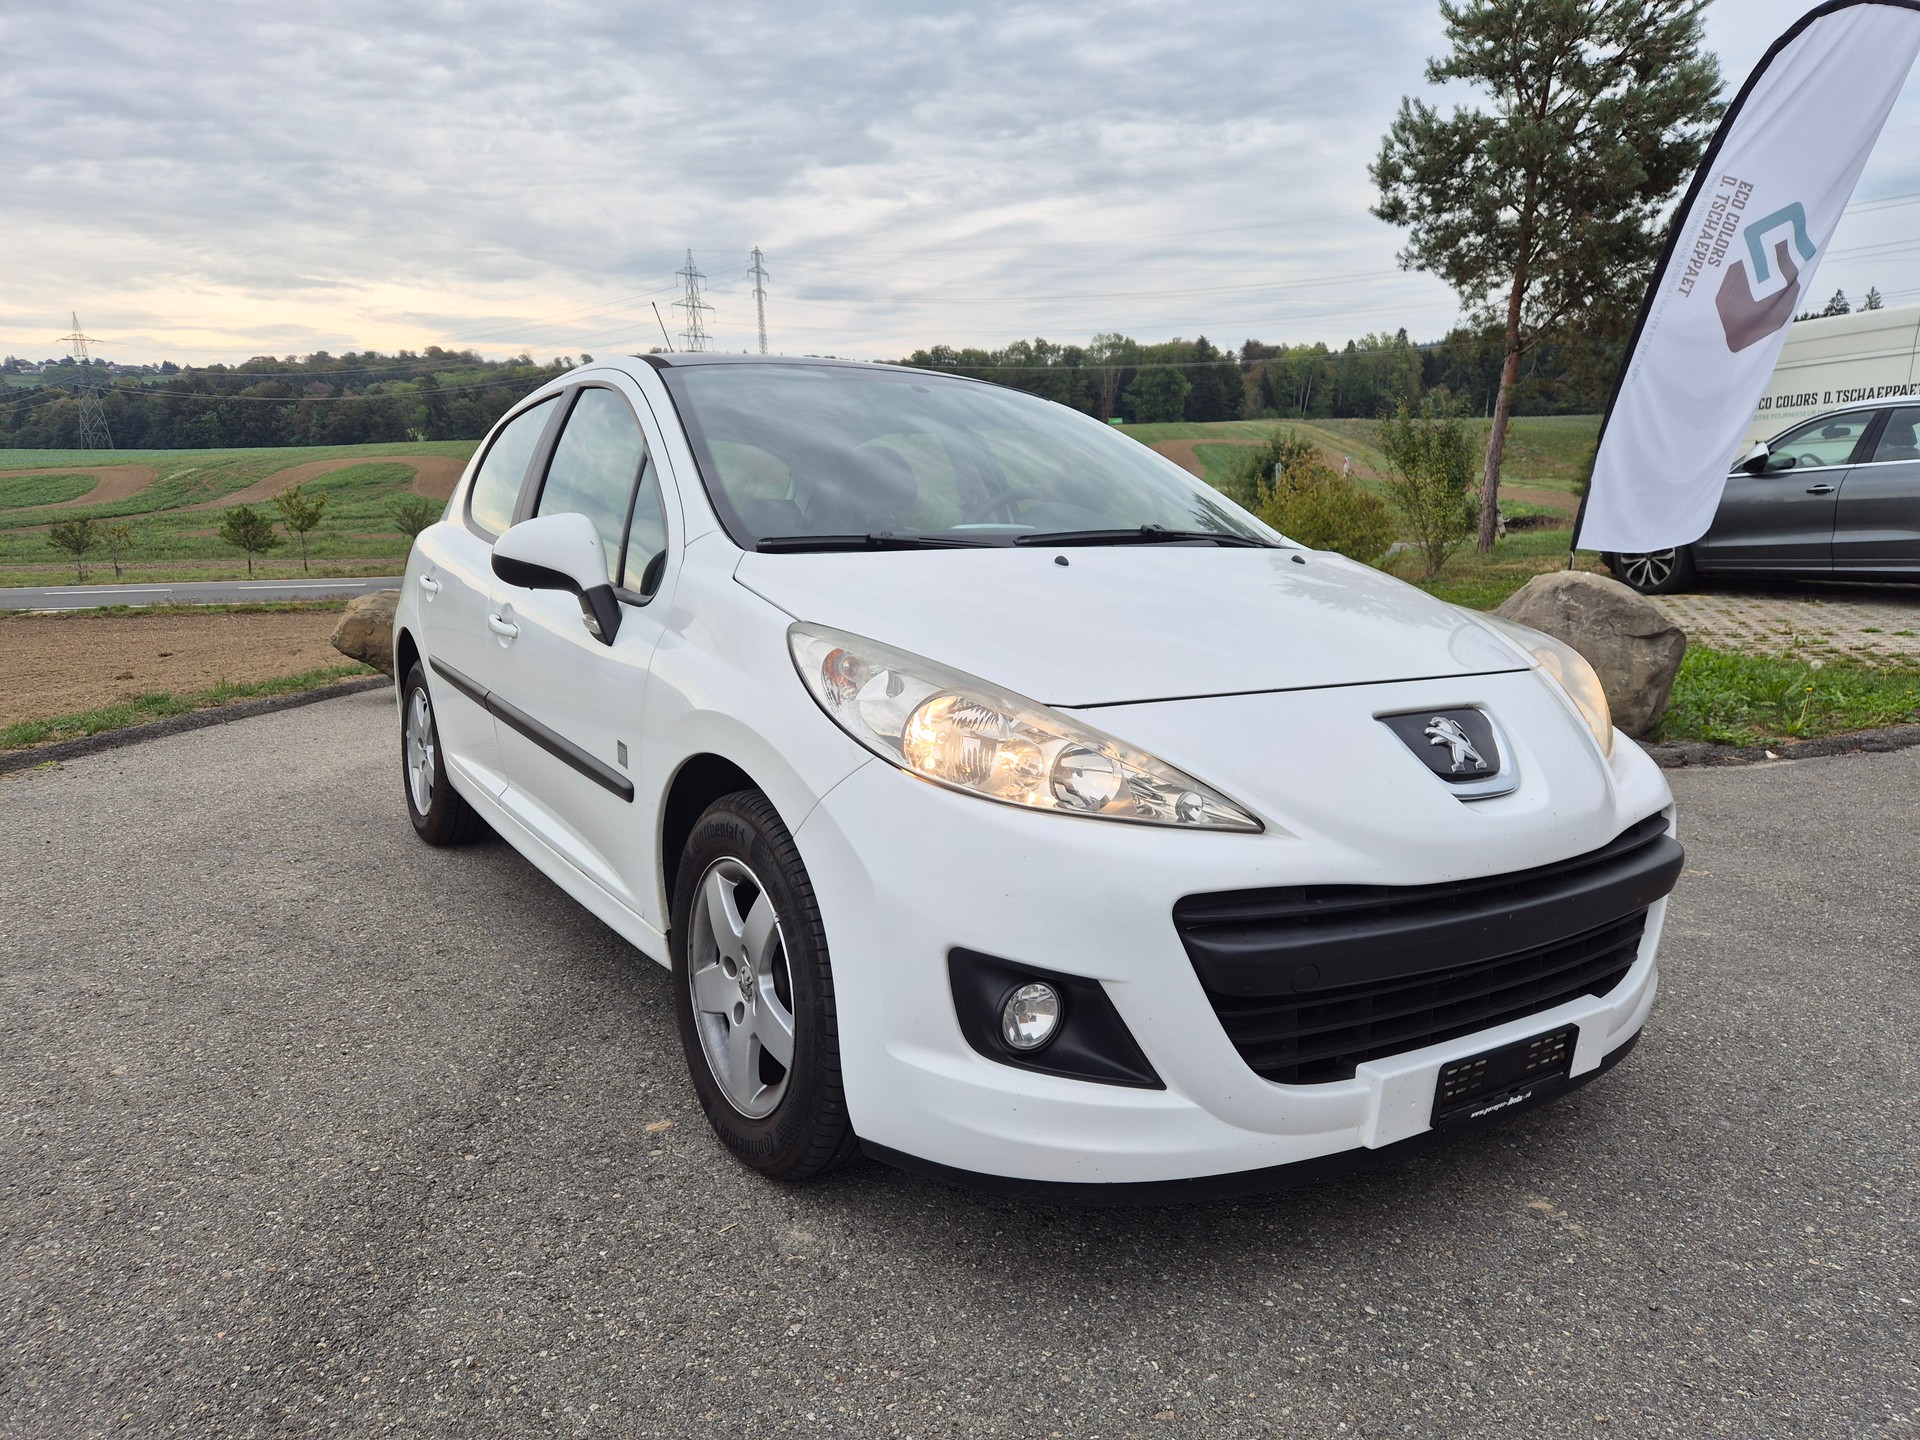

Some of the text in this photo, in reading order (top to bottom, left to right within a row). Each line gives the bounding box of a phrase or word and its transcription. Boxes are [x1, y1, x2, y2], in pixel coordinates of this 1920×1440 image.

[1678, 174, 1738, 298] D. TSCHAEPPAET
[1679, 200, 1706, 259] FOURNISSEUR
[1708, 180, 1754, 268] ECO COLORS
[1753, 411, 1769, 421] OTRE
[1770, 409, 1817, 420] FOURNISSEUR
[1757, 396, 1773, 411] CO
[1775, 392, 1819, 409] COLORS
[1823, 391, 1834, 404] D.
[692, 820, 739, 854] Continental
